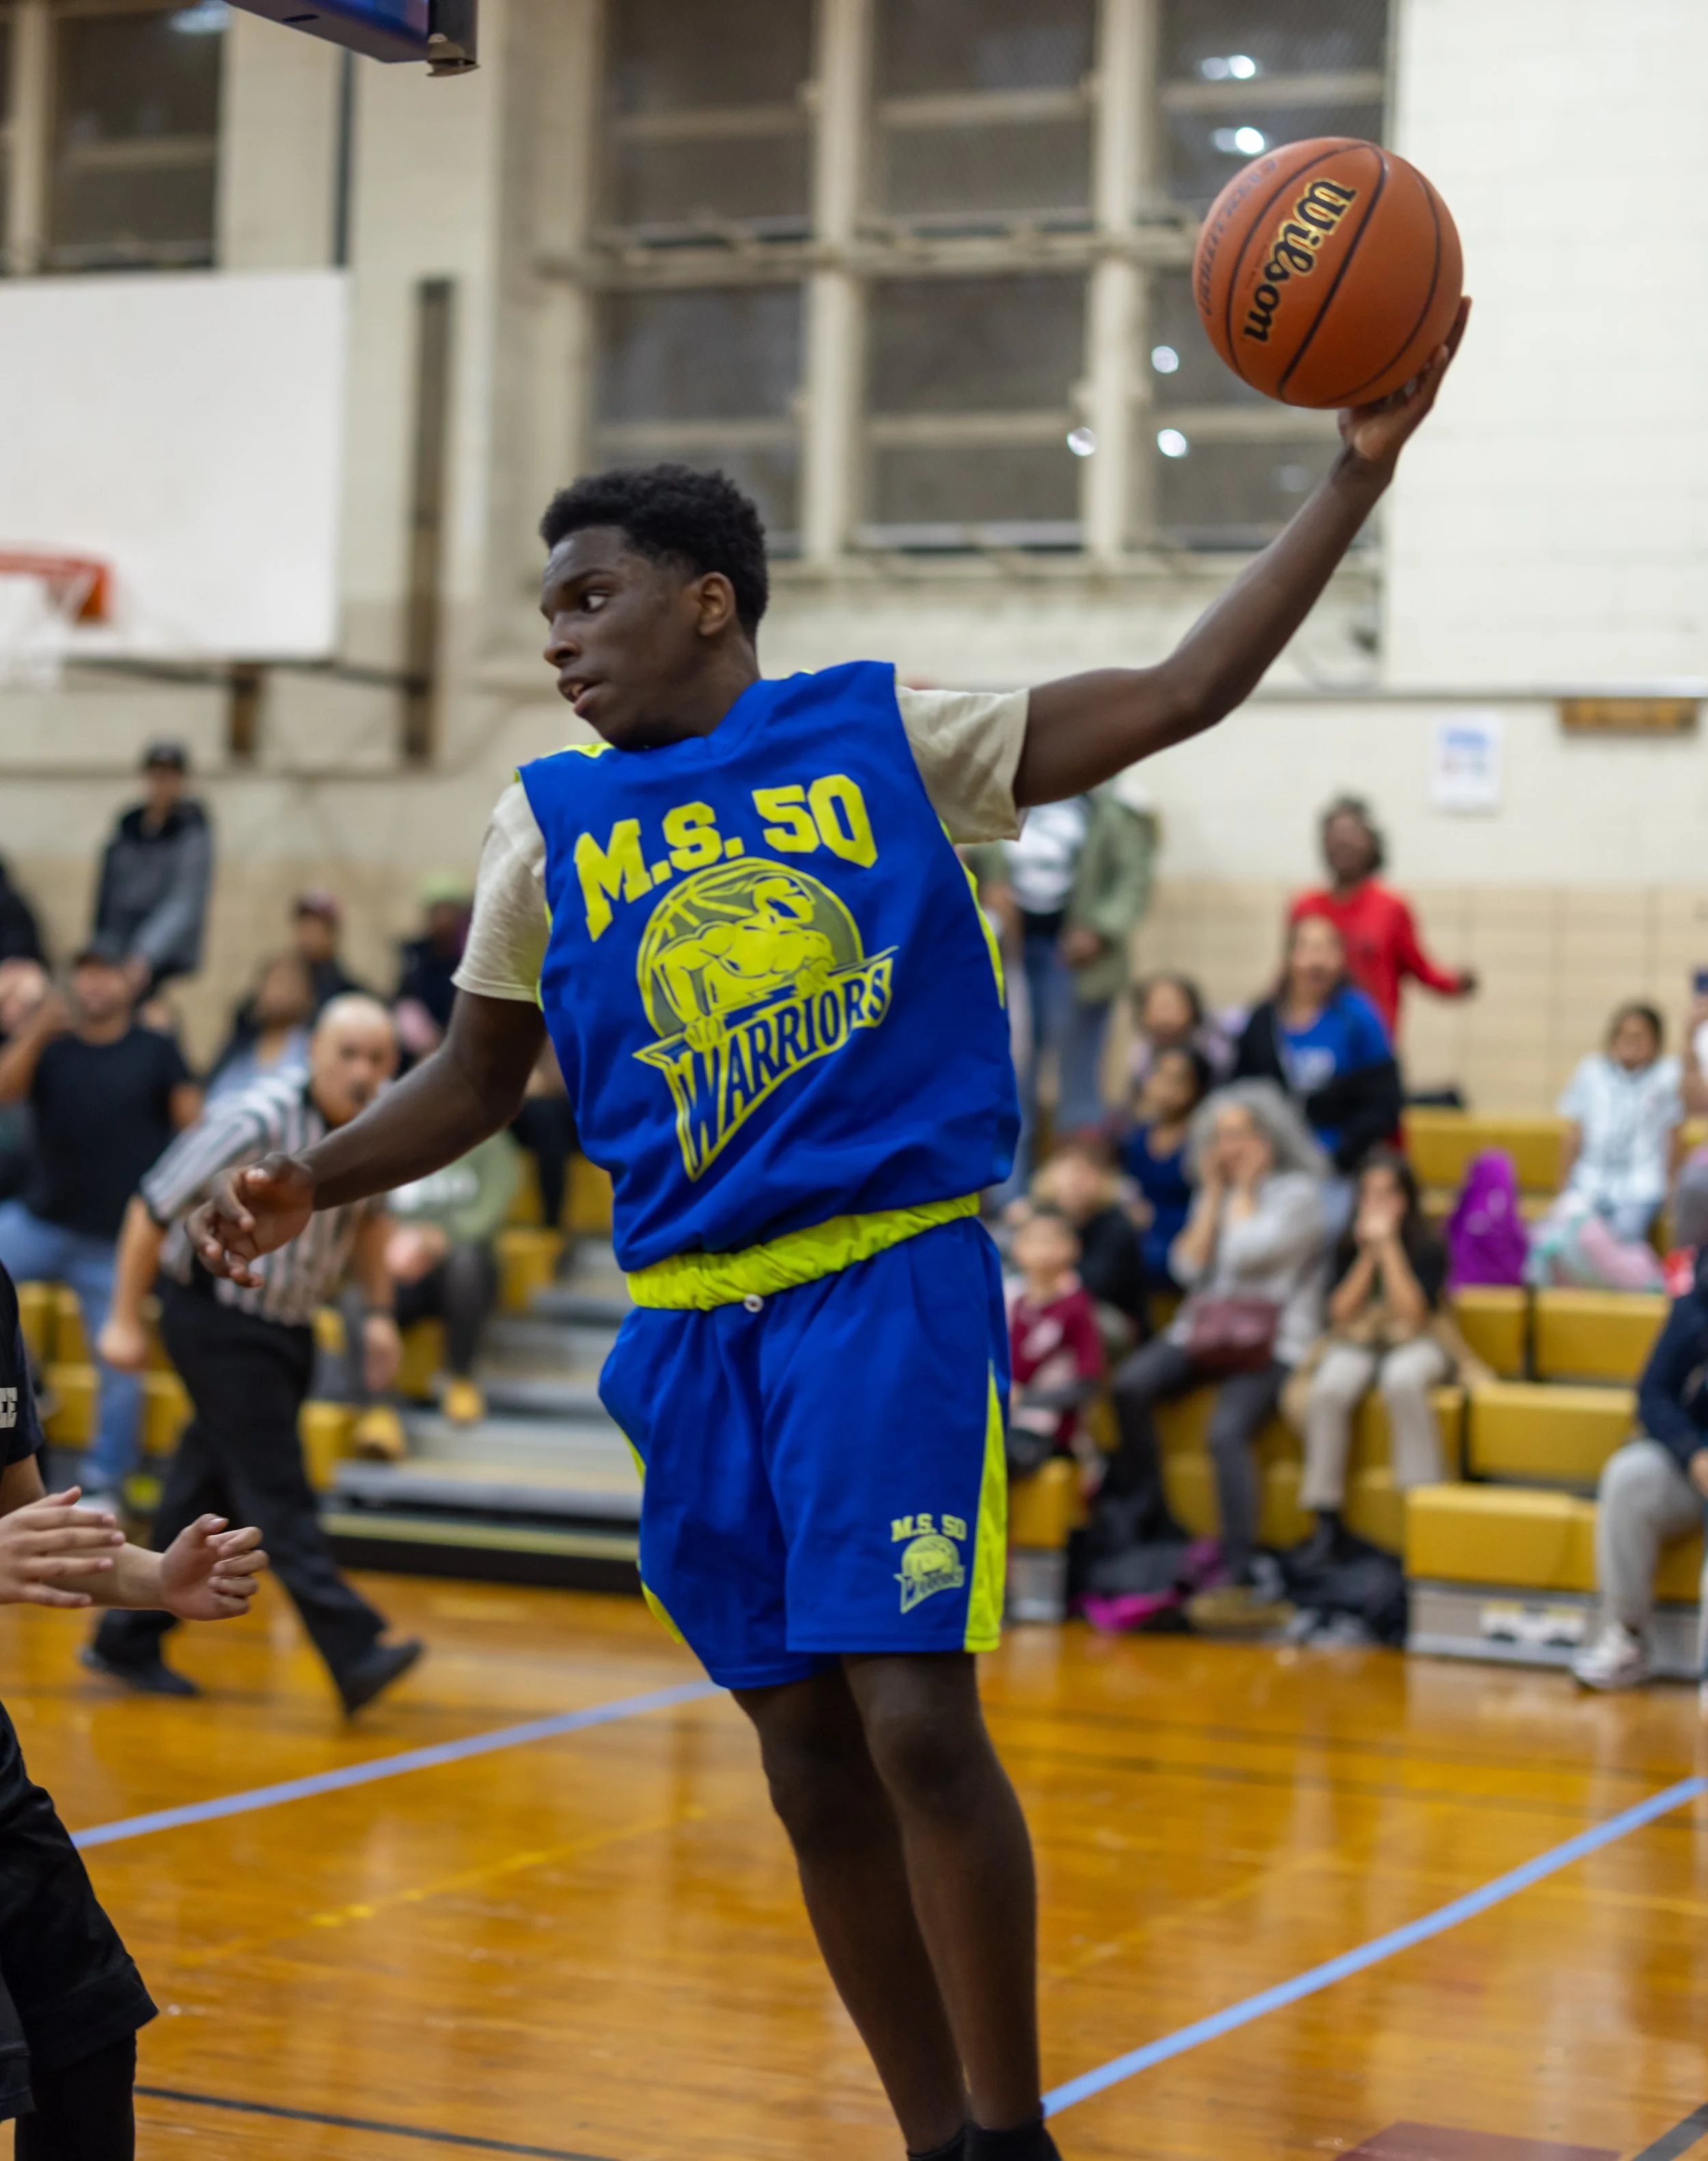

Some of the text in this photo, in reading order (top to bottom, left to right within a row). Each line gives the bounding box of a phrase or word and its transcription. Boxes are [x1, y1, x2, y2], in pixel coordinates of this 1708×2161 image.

[1243, 178, 1358, 342] Wilson
[574, 773, 878, 942] M.S. 50
[650, 956, 893, 1181] WARRIORS
[890, 1513, 967, 1543] M.S. 50
